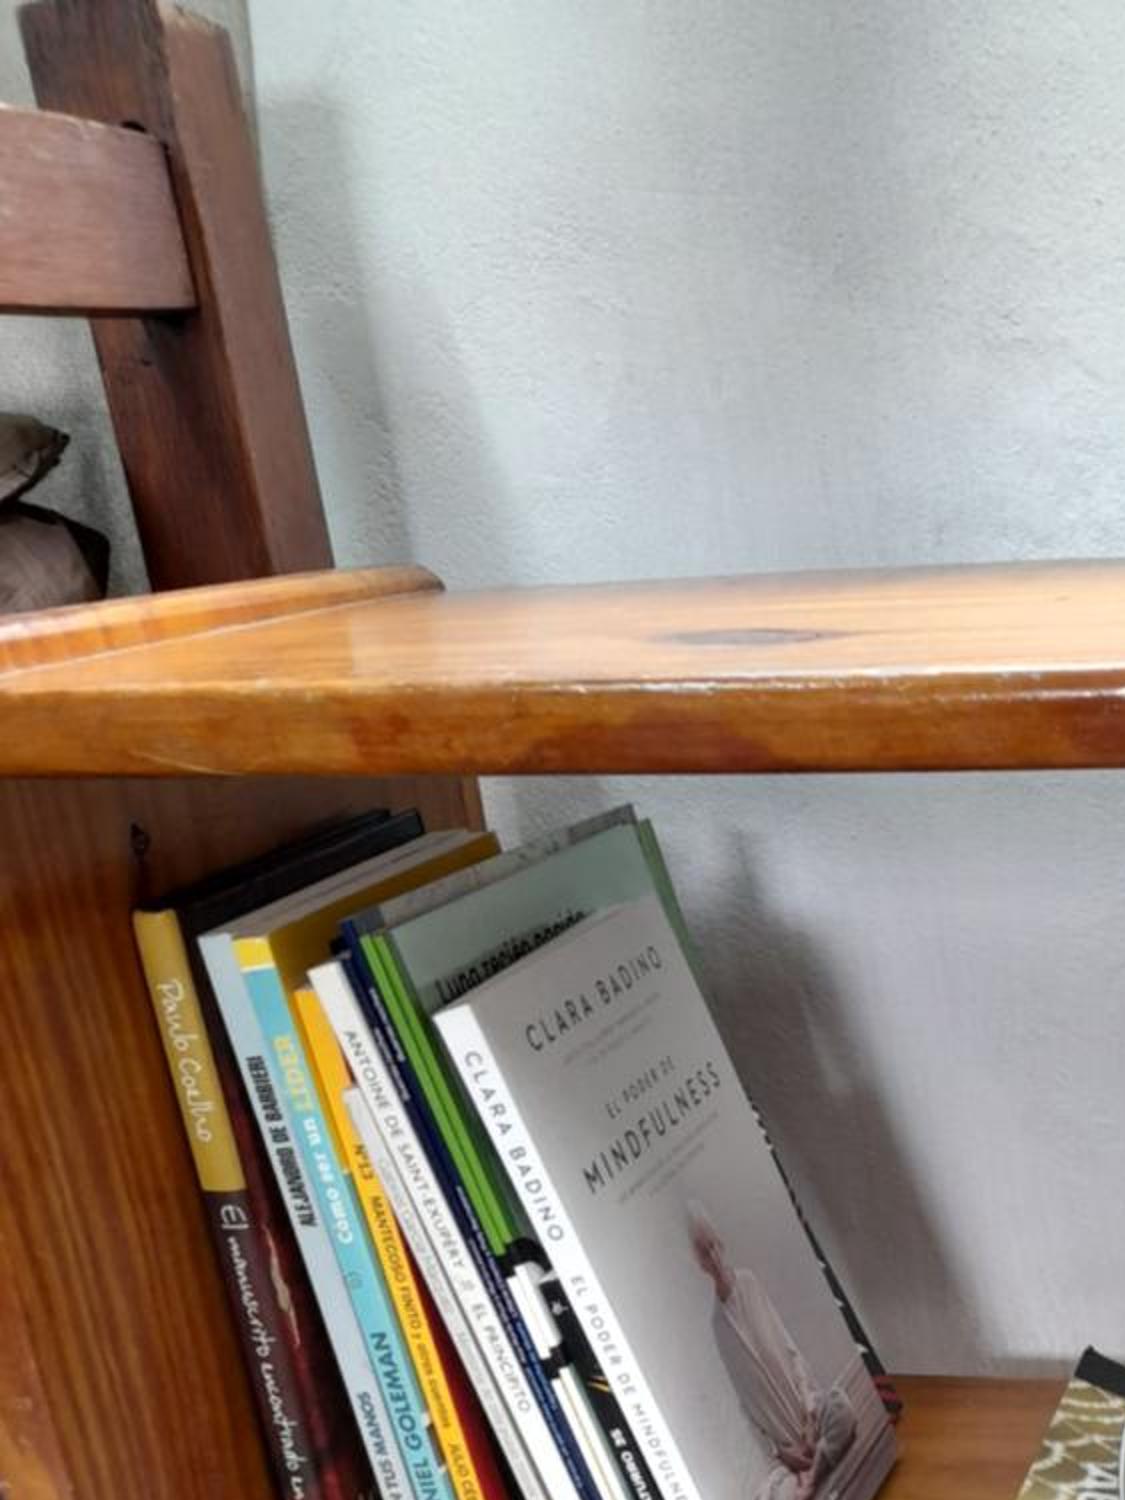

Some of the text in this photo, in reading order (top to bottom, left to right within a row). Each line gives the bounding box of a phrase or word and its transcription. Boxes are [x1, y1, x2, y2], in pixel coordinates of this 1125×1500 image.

[525, 994, 593, 1051] CLARA
[595, 945, 663, 1005] BADINO
[156, 977, 214, 1145] Paulo Coelho
[345, 1030, 390, 1113] ANTOINE
[383, 1114, 405, 1139] DE
[606, 1100, 621, 1119] EL
[622, 1066, 659, 1103] PODER
[245, 1055, 318, 1228] ALEJANDRO DE BARBIERI
[303, 1117, 324, 1146] un
[465, 1050, 512, 1137] CLARA
[509, 1145, 564, 1242] BADINO
[582, 1061, 722, 1196] MINDFULNESS
[219, 1203, 249, 1230] El
[228, 1236, 271, 1358] manuscrito
[398, 1281, 422, 1331] FINITO
[571, 1275, 589, 1297] EL
[586, 1304, 626, 1372] PODER
[618, 1374, 637, 1396] DE
[371, 1332, 426, 1452] GOLEMAN
[471, 1303, 486, 1322] EL
[483, 1320, 532, 1413] PRINCIPITO
[261, 1357, 310, 1474] encontrado
[356, 1392, 385, 1456] MANOS
[380, 1459, 399, 1494] TUS
